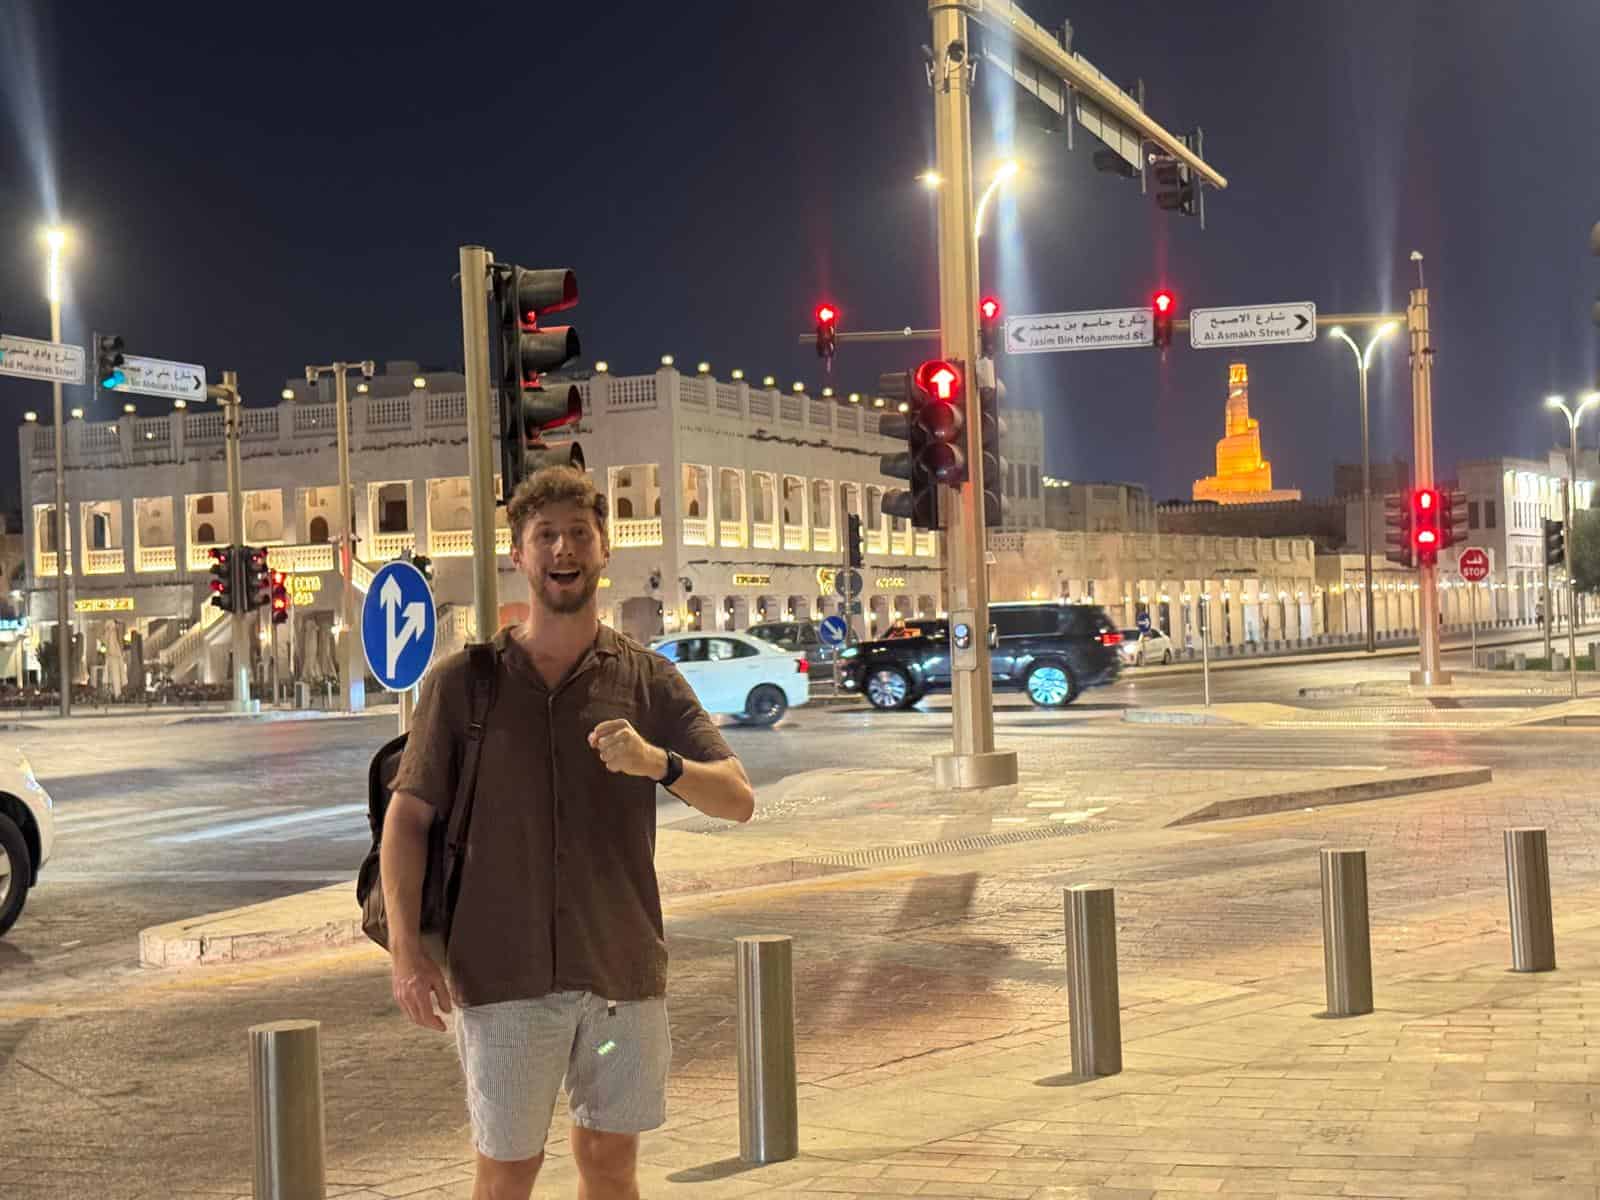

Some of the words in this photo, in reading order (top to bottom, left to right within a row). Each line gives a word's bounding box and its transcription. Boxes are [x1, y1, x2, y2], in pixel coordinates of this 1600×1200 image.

[1117, 314, 1148, 329] شارع
[1256, 311, 1286, 325] شارع
[1063, 321, 1078, 331] بن
[1030, 334, 1056, 347] Jasim
[1057, 334, 1074, 345] Bin
[1075, 331, 1131, 345] Mohammed
[1204, 330, 1215, 340] Al
[1217, 328, 1256, 340] Asmakh
[1258, 327, 1291, 338] Street
[1466, 553, 1483, 565] قف
[1463, 567, 1486, 577] STOP
